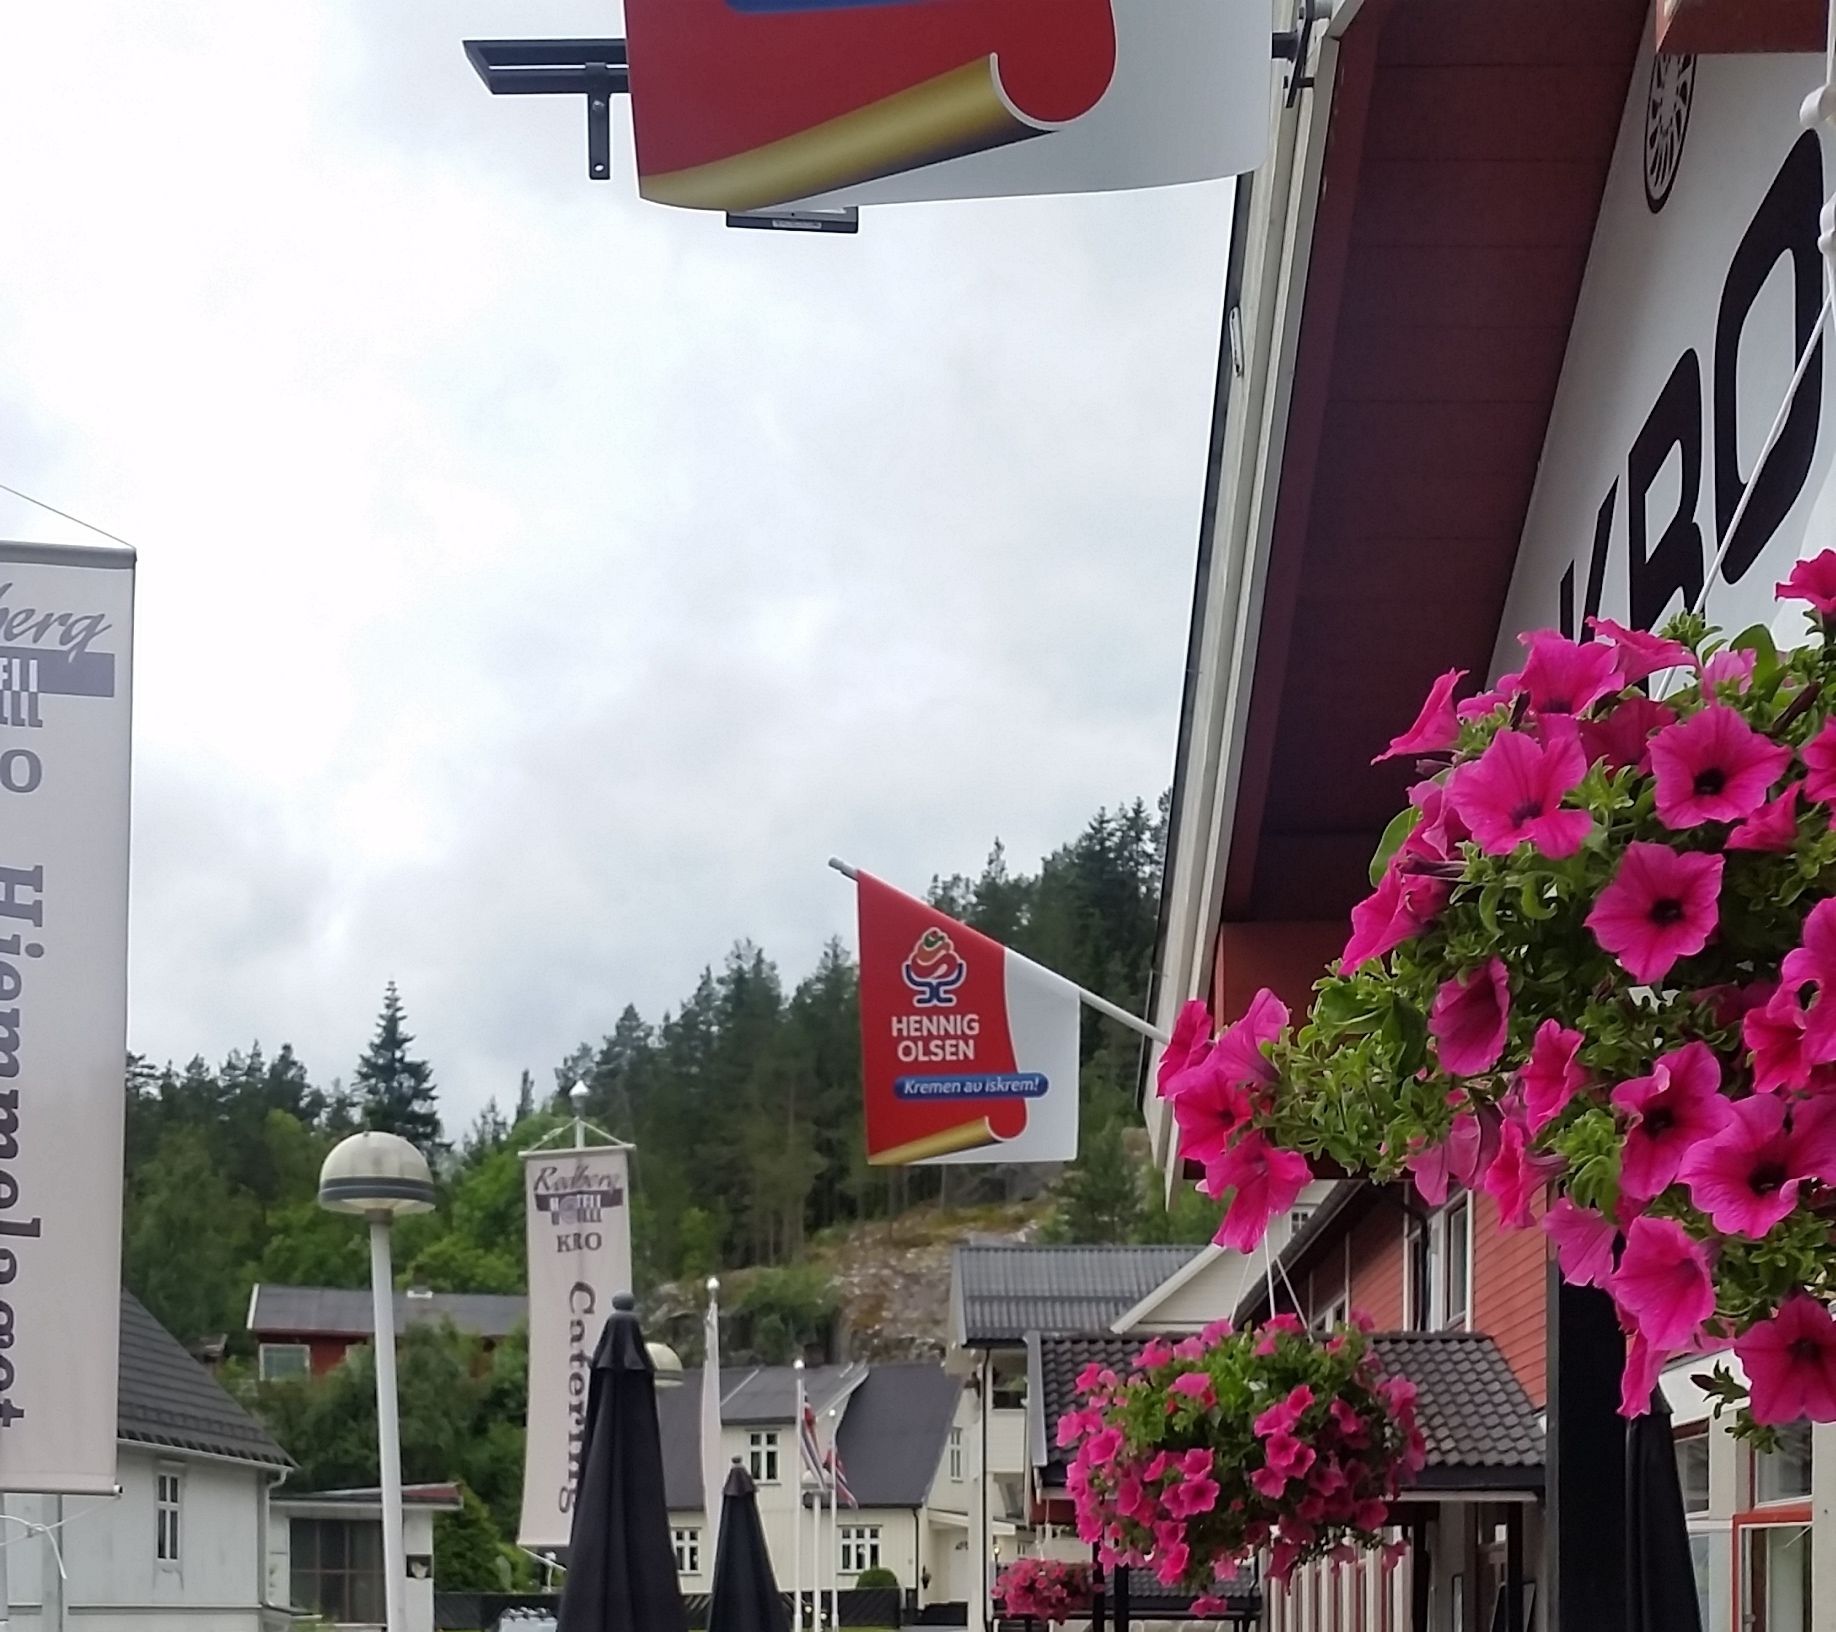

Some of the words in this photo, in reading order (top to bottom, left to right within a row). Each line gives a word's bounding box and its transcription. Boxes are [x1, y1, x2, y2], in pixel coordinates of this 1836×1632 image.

[891, 1013, 980, 1037] HENNIG
[897, 1039, 975, 1062] OLSEN
[904, 1079, 961, 1094] Kremen
[963, 1083, 982, 1093] av
[985, 1076, 1040, 1092] iskrem!
[556, 1232, 602, 1253] KRO
[558, 1281, 597, 1514] Catering
